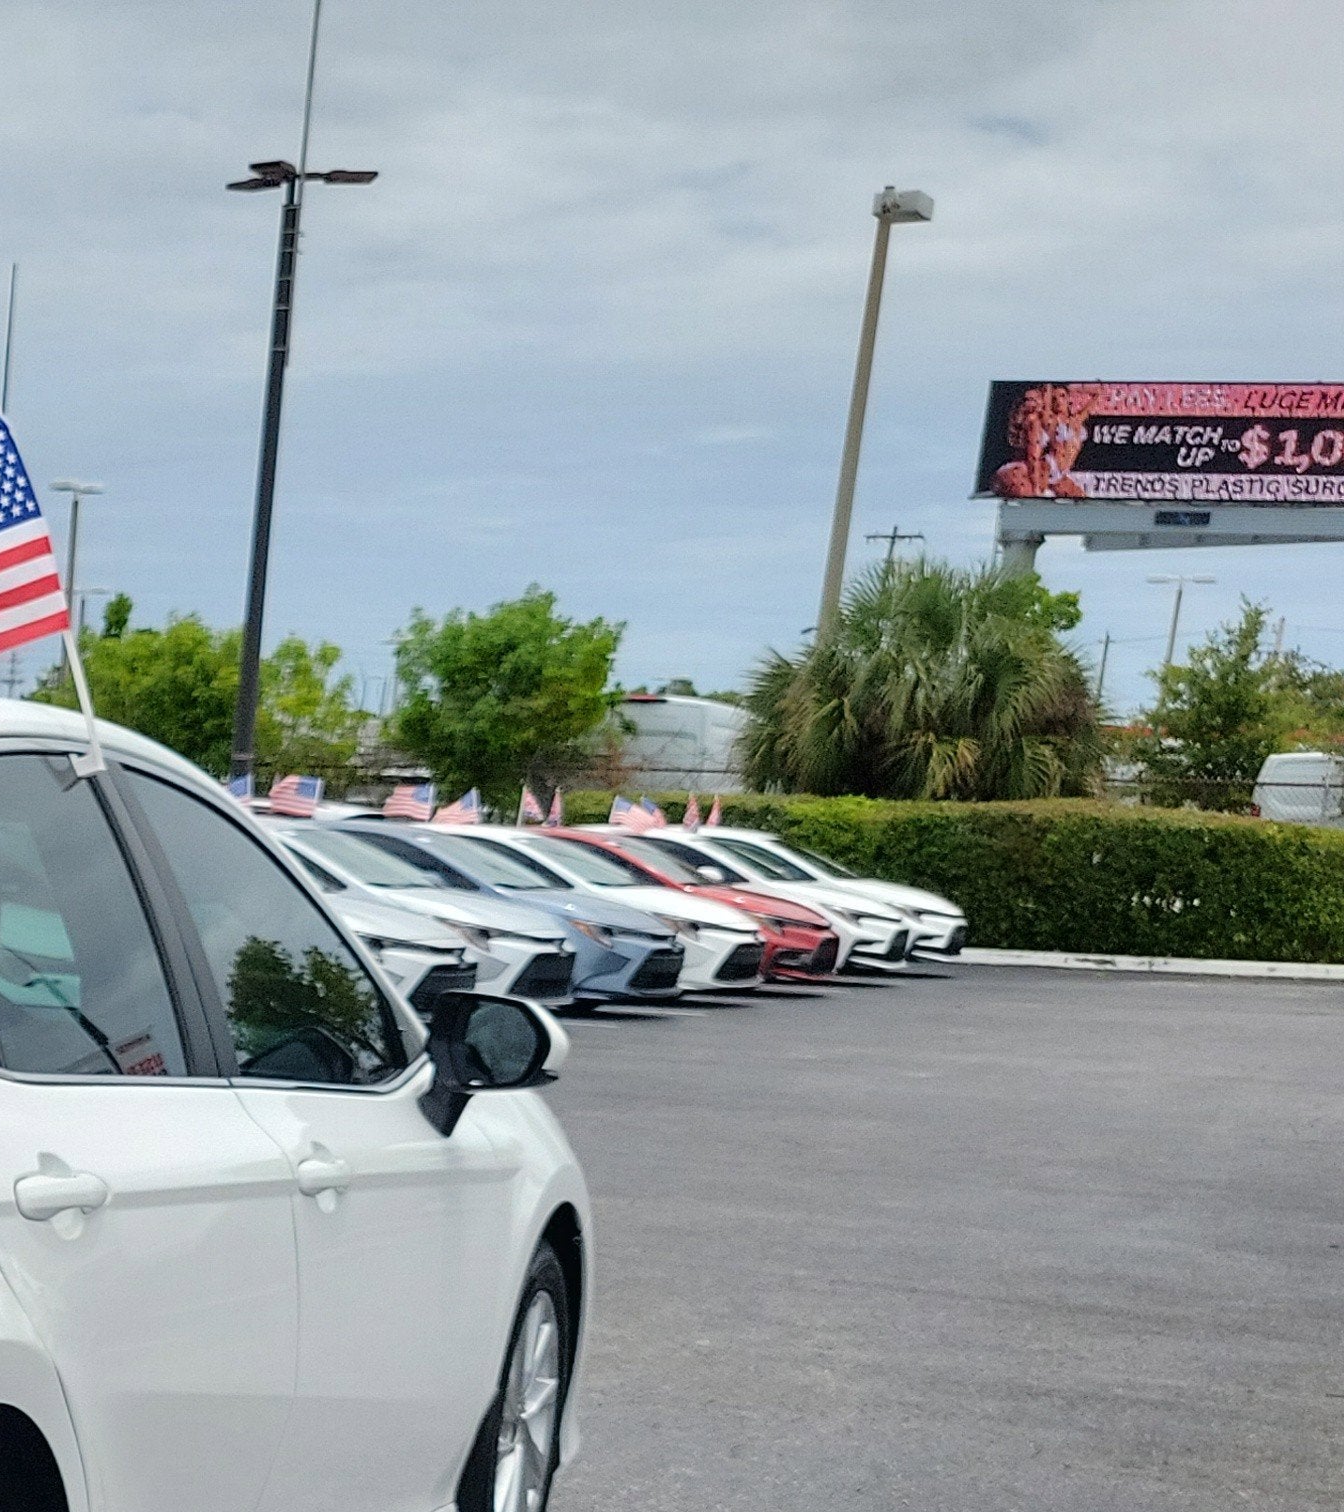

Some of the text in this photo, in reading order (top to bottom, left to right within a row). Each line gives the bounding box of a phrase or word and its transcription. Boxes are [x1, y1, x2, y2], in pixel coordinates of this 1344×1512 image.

[1093, 424, 1224, 446] WE MATCH
[1220, 439, 1242, 453] TO
[1176, 446, 1215, 468] UP
